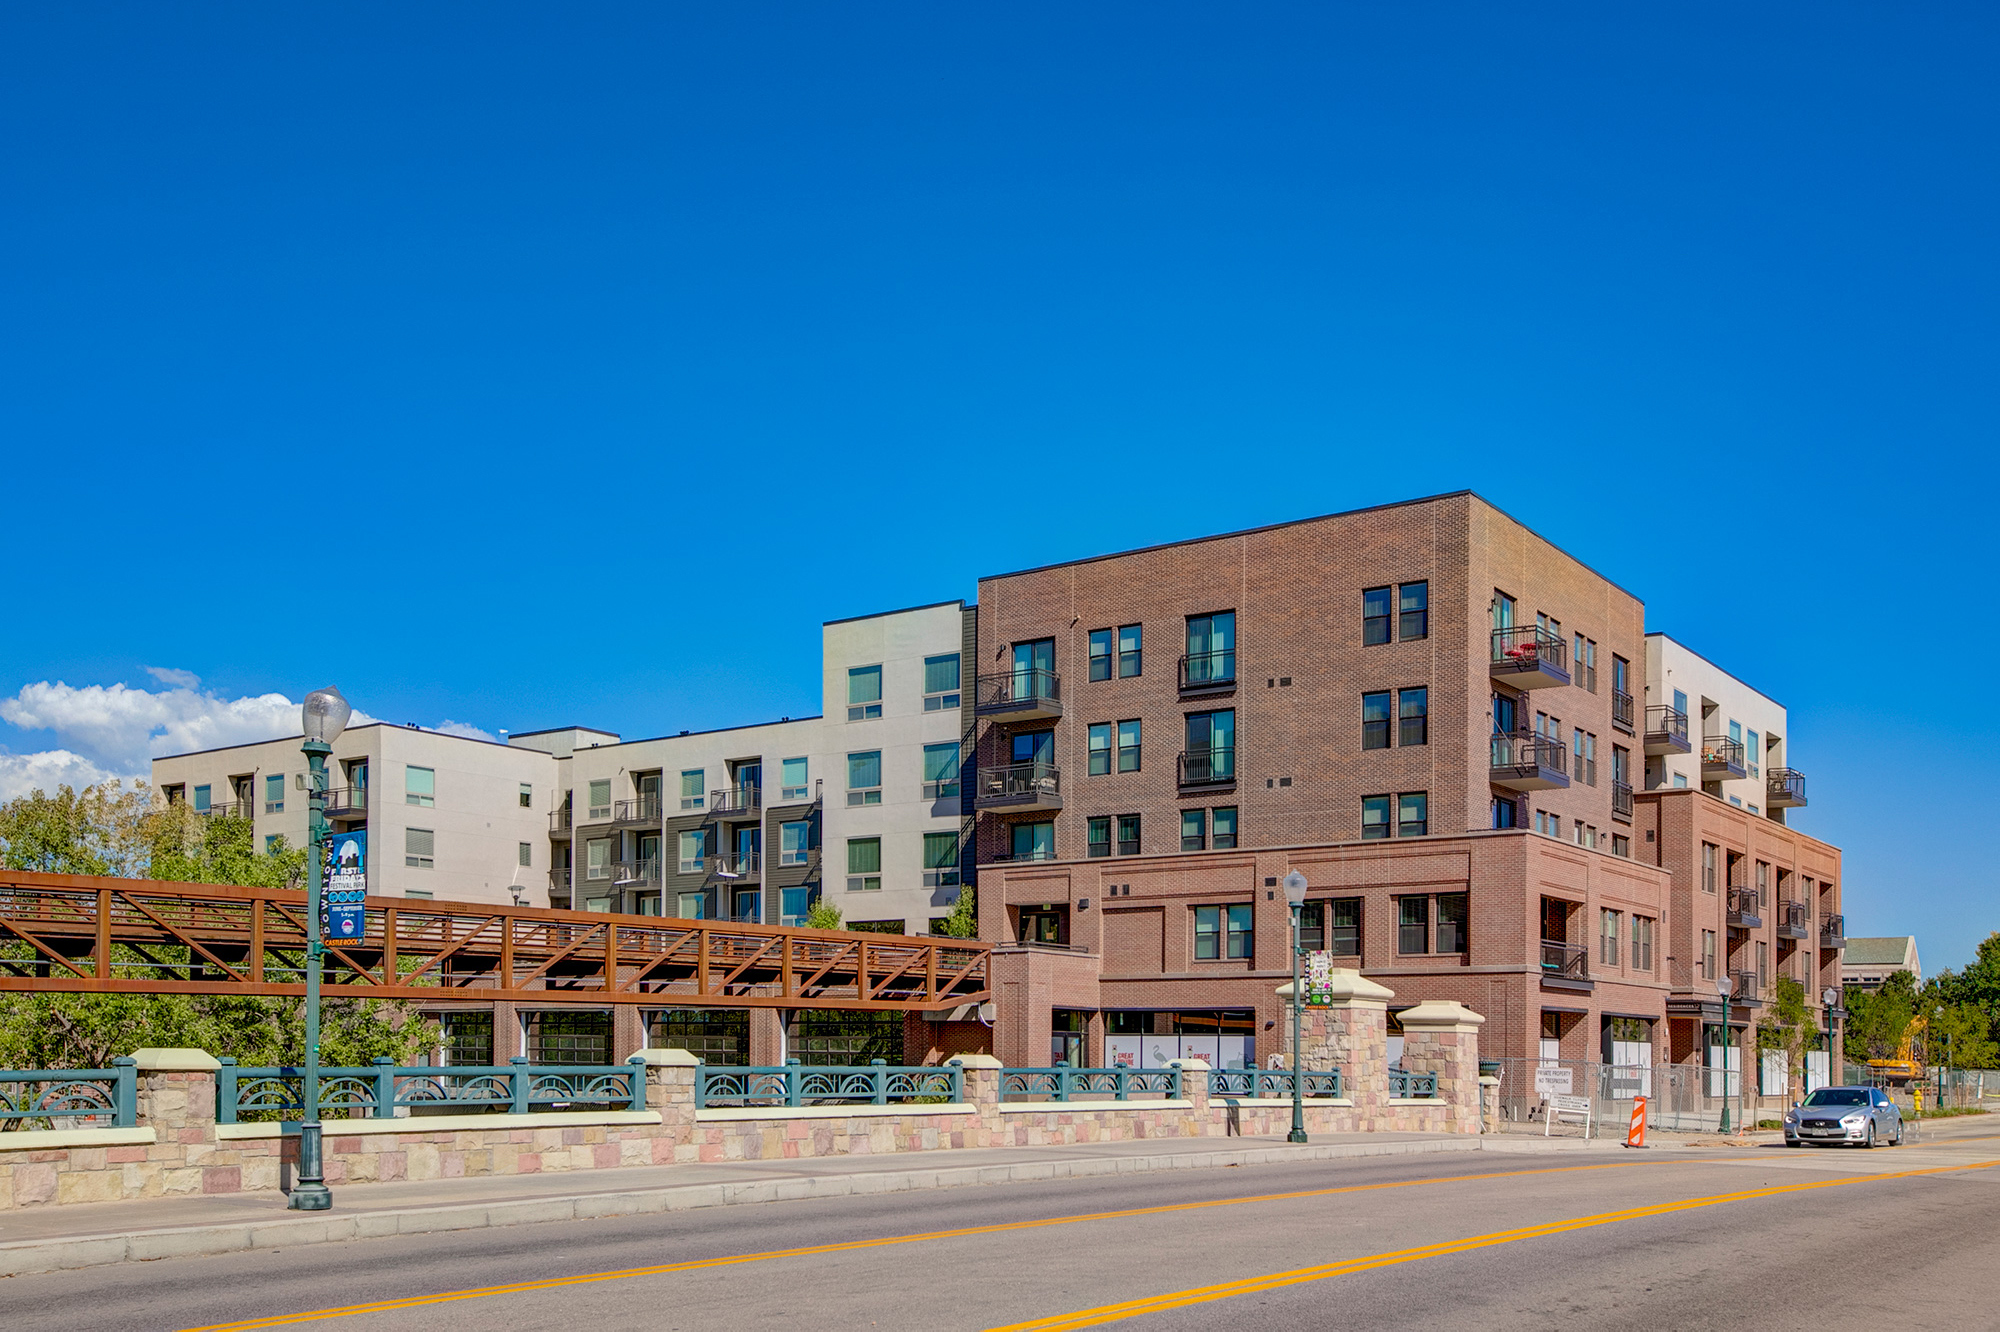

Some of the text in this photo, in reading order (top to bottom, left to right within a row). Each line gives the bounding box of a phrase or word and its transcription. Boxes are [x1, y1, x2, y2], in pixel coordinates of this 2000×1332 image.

[330, 874, 365, 882] FRIDAYS
[321, 840, 334, 934] DOWNTOWN
[330, 881, 365, 890] FESTIVAL PARK
